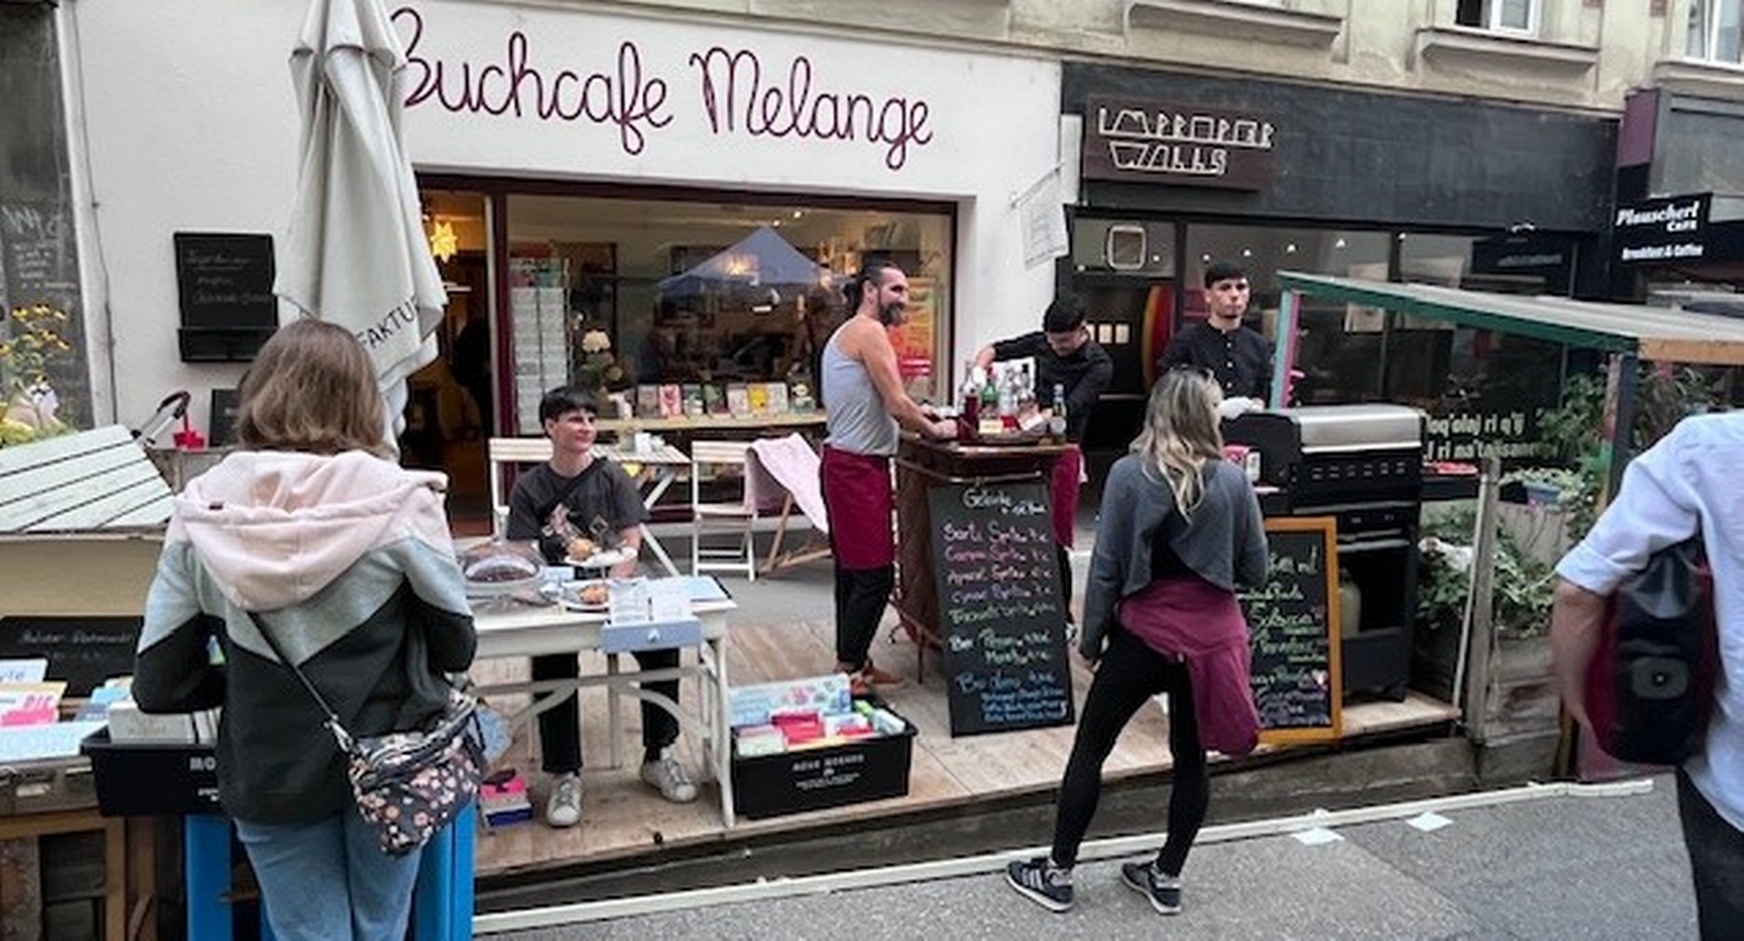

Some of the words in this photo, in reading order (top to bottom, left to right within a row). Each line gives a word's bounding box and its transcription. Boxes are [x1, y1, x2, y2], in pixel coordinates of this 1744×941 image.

[391, 8, 673, 154] Buchcafe
[689, 47, 933, 170] Melange
[1099, 108, 1274, 149] IMPROPER
[1109, 141, 1228, 175] WALLS
[1615, 201, 1700, 227] Plauscherl
